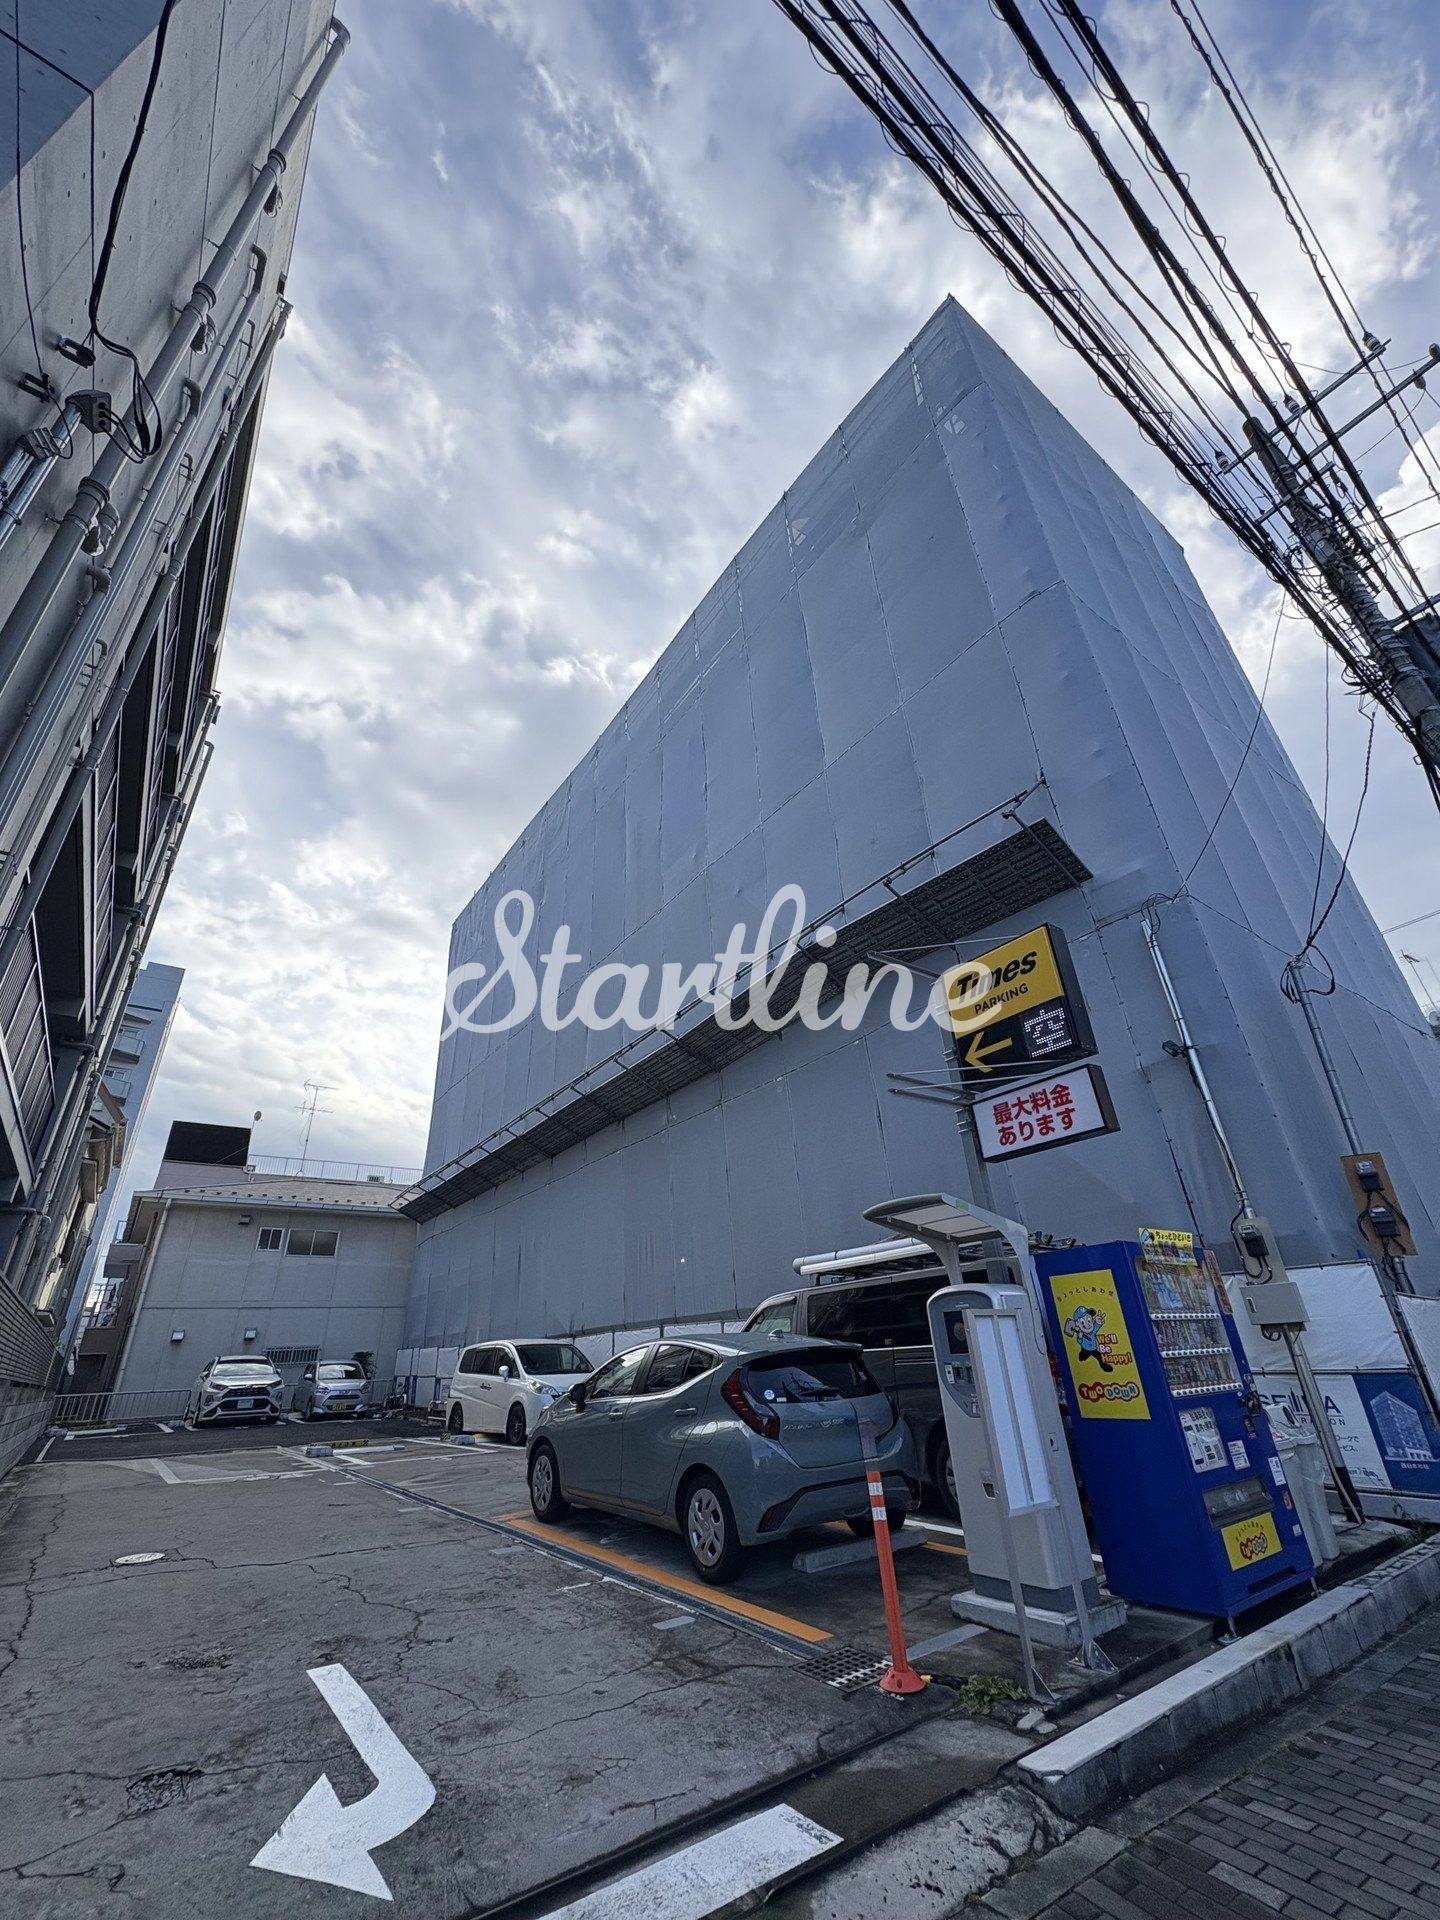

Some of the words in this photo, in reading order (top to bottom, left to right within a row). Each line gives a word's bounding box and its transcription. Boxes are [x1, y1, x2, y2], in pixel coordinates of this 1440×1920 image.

[956, 951, 1038, 1004] Times
[974, 983, 1029, 1014] PARKING
[1024, 1007, 1073, 1058] 空
[992, 1083, 1074, 1125] 最大料金
[998, 1107, 1076, 1146] あります
[1057, 1286, 1115, 1302] ちょっとしあわせ
[1096, 1334, 1118, 1344] We'll
[1099, 1345, 1111, 1354] Be
[1101, 1352, 1133, 1364] Happy!
[1080, 1384, 1104, 1401] TWO
[1105, 1384, 1137, 1400] DOWN
